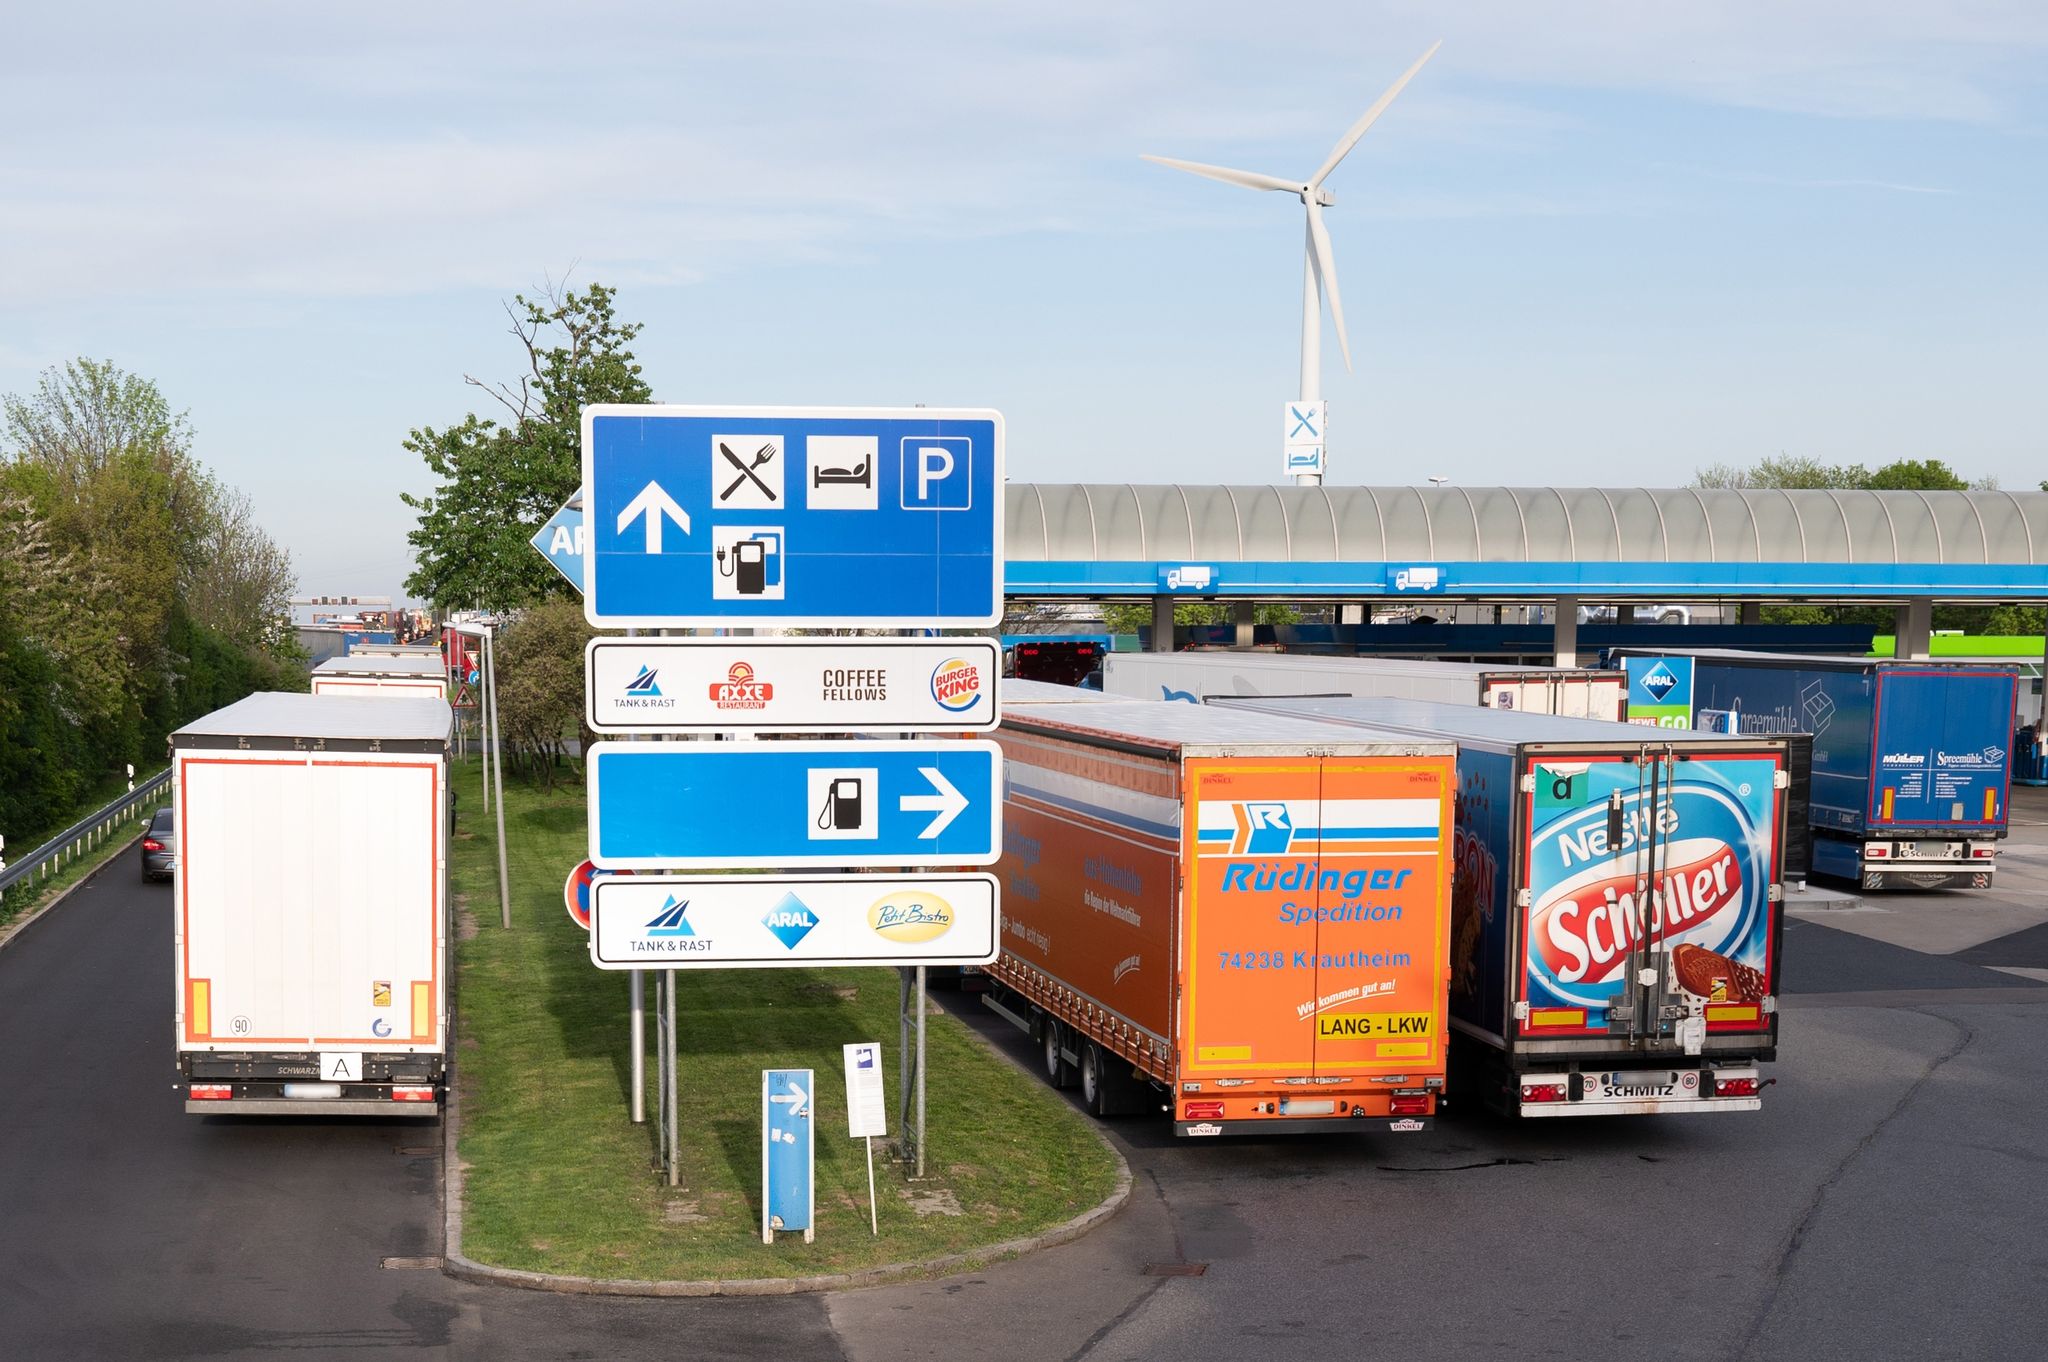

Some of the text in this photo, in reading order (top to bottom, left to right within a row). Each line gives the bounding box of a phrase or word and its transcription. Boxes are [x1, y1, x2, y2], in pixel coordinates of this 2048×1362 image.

[917, 446, 955, 500] P
[823, 669, 886, 688] COFFEE
[936, 666, 978, 687] BURGER
[1645, 675, 1674, 686] ARAL
[718, 684, 765, 701] AXXE
[823, 688, 886, 702] FELLOWS
[937, 676, 980, 701] KING
[614, 699, 642, 708] TANK
[650, 699, 676, 708] RAST
[719, 701, 763, 709] RESTAURANT
[1660, 715, 1688, 730] GO
[1733, 697, 1797, 734] preemühle
[1937, 751, 1983, 767] Spreemühle
[1558, 798, 1679, 868] Nestlé
[1221, 862, 1413, 899] Rüdinger
[767, 913, 813, 927] ARAL
[878, 904, 949, 925] Petit Bistro
[1279, 902, 1403, 927] Spedition
[1547, 854, 1731, 984] Schöller
[630, 940, 713, 952] TANK & RAST
[1218, 949, 1411, 970] 74238 Krautheim
[1297, 979, 1396, 1017] Wir kommen gut an!
[234, 1019, 247, 1033] 90
[1320, 1017, 1371, 1035] LANG
[1388, 1016, 1429, 1033] LKW
[332, 1058, 351, 1078] A
[1584, 1080, 1594, 1089] 70
[1603, 1085, 1674, 1097] SCHMITZ
[1685, 1077, 1695, 1086] 80
